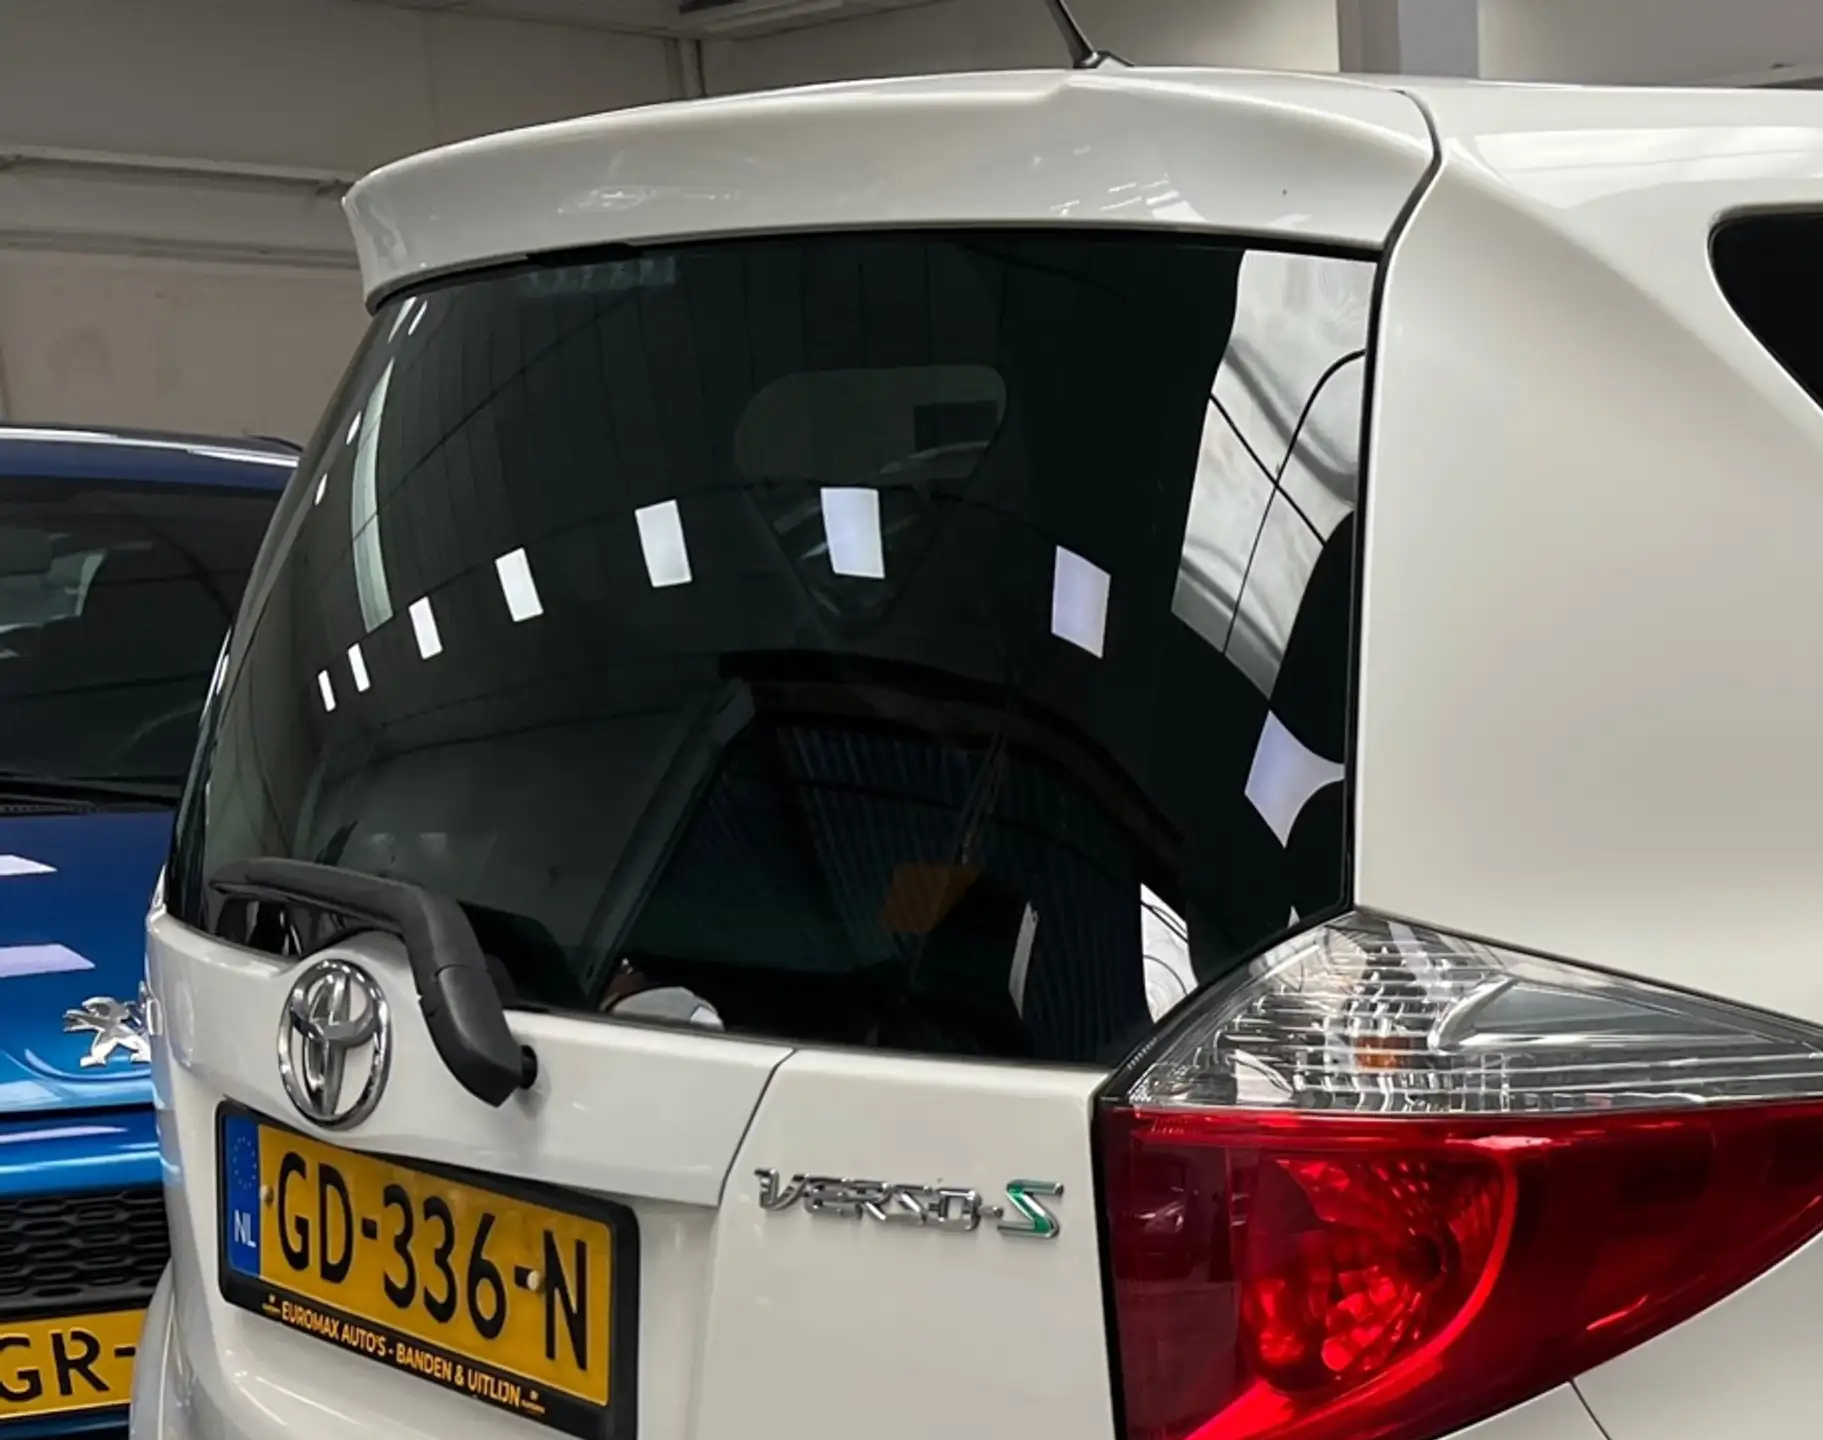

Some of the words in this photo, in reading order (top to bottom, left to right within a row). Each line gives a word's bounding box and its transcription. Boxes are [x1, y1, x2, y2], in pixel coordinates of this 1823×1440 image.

[234, 1208, 257, 1248] NL
[754, 1168, 1064, 1238] VERSO-S
[277, 1151, 588, 1372] GD-336-N
[281, 1300, 340, 1342] EUROMAX
[341, 1322, 387, 1357] AUTO'S
[396, 1342, 452, 1381] BANDEN
[454, 1365, 465, 1387] &
[467, 1368, 522, 1408] UITLIJN
